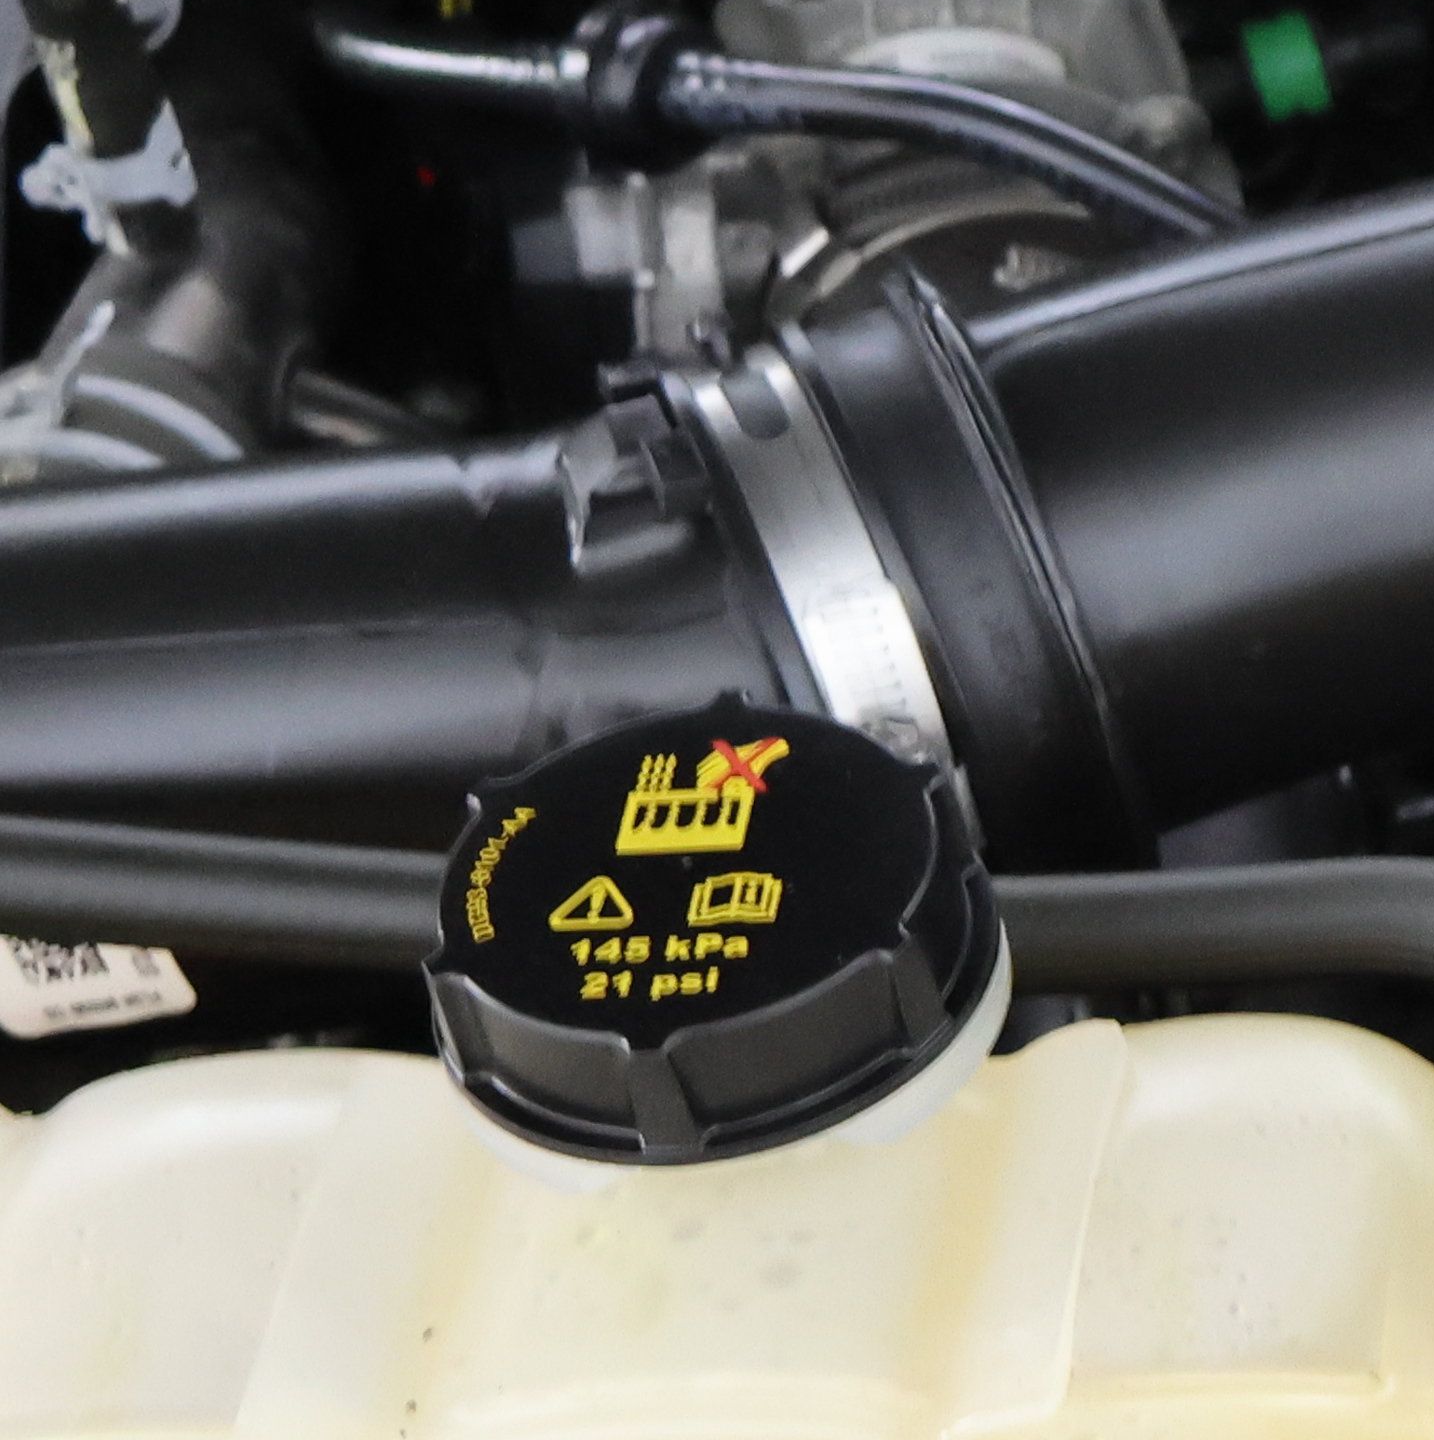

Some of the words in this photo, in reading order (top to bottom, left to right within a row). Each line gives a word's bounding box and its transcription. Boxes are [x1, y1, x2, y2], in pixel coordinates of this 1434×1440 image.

[570, 935, 651, 966] 145
[665, 932, 748, 962] kPa
[580, 970, 633, 1000] 21
[651, 965, 719, 1002] psi
